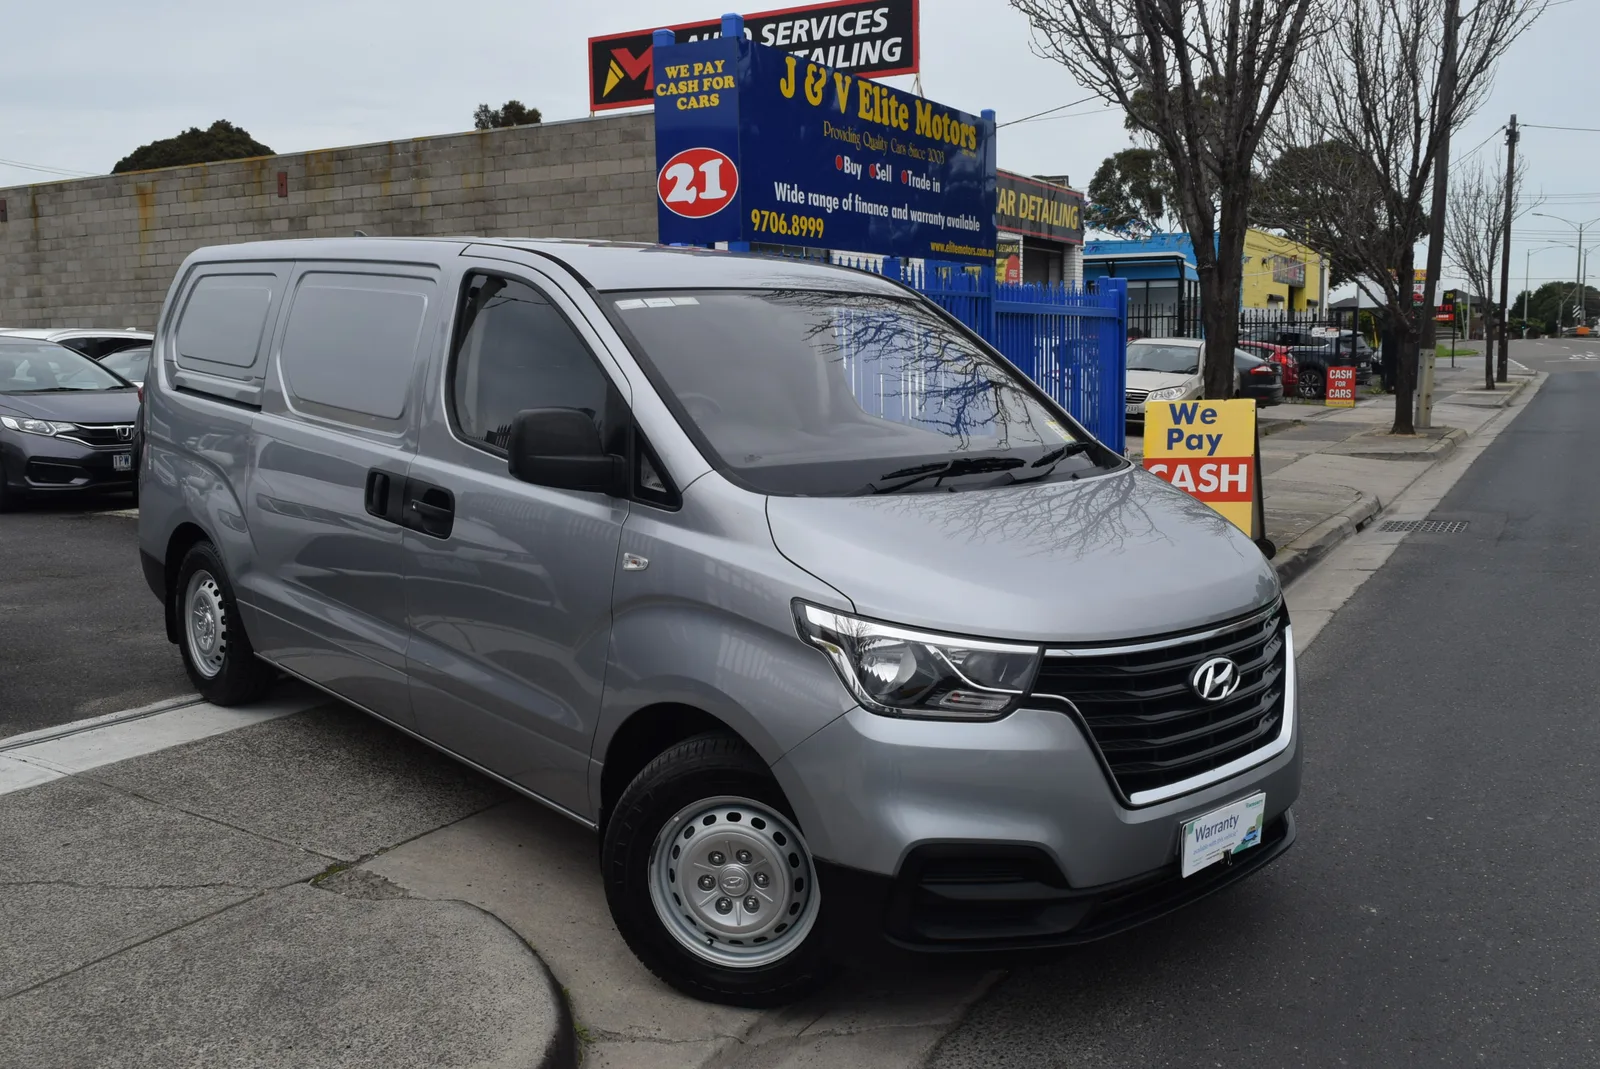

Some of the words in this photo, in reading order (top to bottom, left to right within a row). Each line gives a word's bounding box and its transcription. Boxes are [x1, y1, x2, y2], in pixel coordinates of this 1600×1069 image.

[760, 7, 888, 46] SERVICES
[665, 64, 689, 78] WE
[693, 59, 724, 75] PAY
[656, 79, 698, 95] CASH
[702, 75, 734, 90] FOR
[676, 93, 719, 109] CARS
[780, 56, 796, 98] J
[804, 63, 826, 105] &
[833, 71, 851, 113] V
[857, 79, 908, 130] Elite
[915, 99, 976, 149] Motors
[823, 120, 860, 150] Providing
[862, 131, 888, 155] Quality
[890, 138, 906, 154] Cars
[907, 142, 925, 159] Since
[927, 147, 944, 163] 2003
[665, 158, 726, 203] 21
[843, 155, 862, 179] Buy
[875, 162, 892, 182] Sell
[907, 169, 930, 190] Trade
[932, 176, 941, 193] in
[774, 181, 804, 204] Wide
[808, 191, 839, 213] range
[842, 192, 853, 211] of
[854, 193, 888, 217] finance
[891, 203, 907, 219] and
[910, 209, 944, 229] warranty
[946, 213, 979, 231] available
[995, 187, 1016, 215] AR
[1018, 192, 1078, 229] DETAILING
[750, 207, 824, 239] 9706.8999
[1329, 369, 1352, 379] CASH
[1328, 388, 1351, 399] CARS
[1169, 402, 1217, 425] We
[1166, 427, 1223, 456] Pay
[1195, 814, 1239, 842] Warranty
